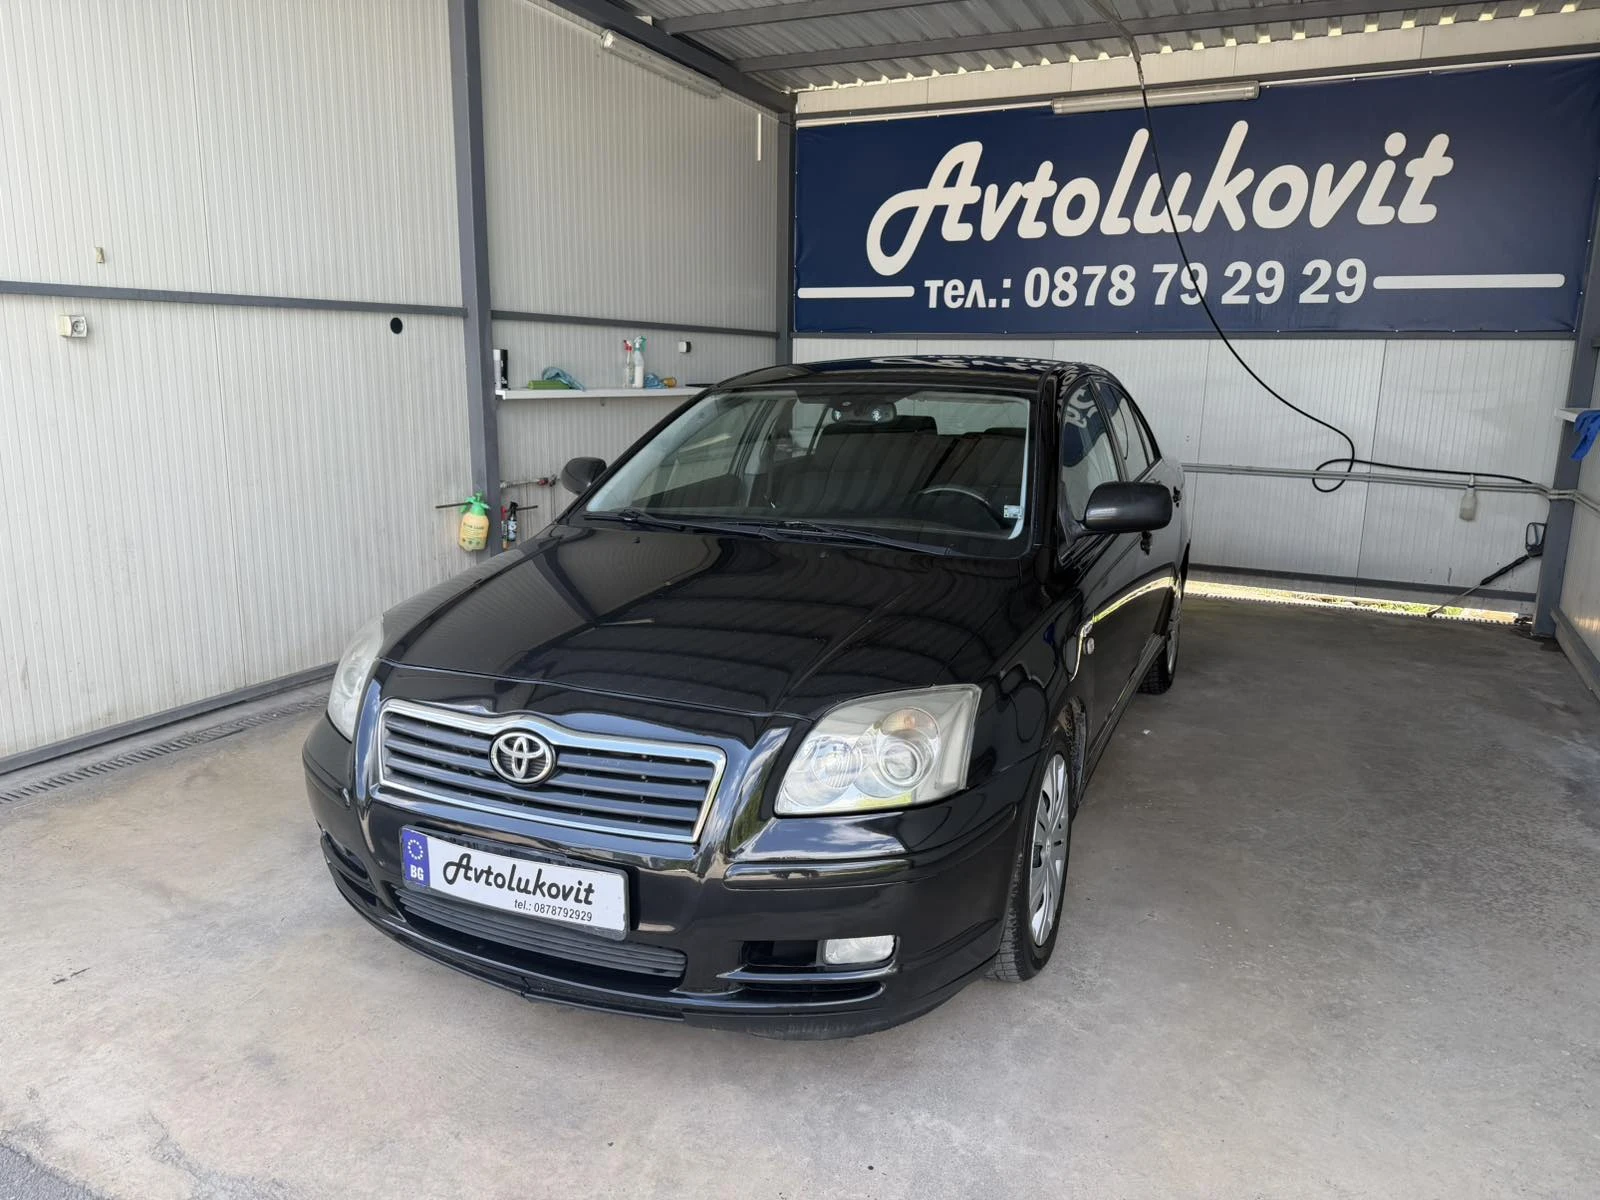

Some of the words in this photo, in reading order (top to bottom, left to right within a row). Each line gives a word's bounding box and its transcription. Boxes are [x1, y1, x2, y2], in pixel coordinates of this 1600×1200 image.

[866, 120, 1454, 276] Avtolukovit
[924, 278, 1012, 309] тел.:
[1024, 264, 1136, 308] 0878
[1152, 262, 1208, 306] 79
[1221, 260, 1285, 305] 29
[1298, 258, 1367, 304] 29
[410, 864, 424, 881] BG
[442, 853, 595, 906] Avtolukovit
[514, 898, 532, 911] tel.:
[533, 902, 593, 922] 0878792929
